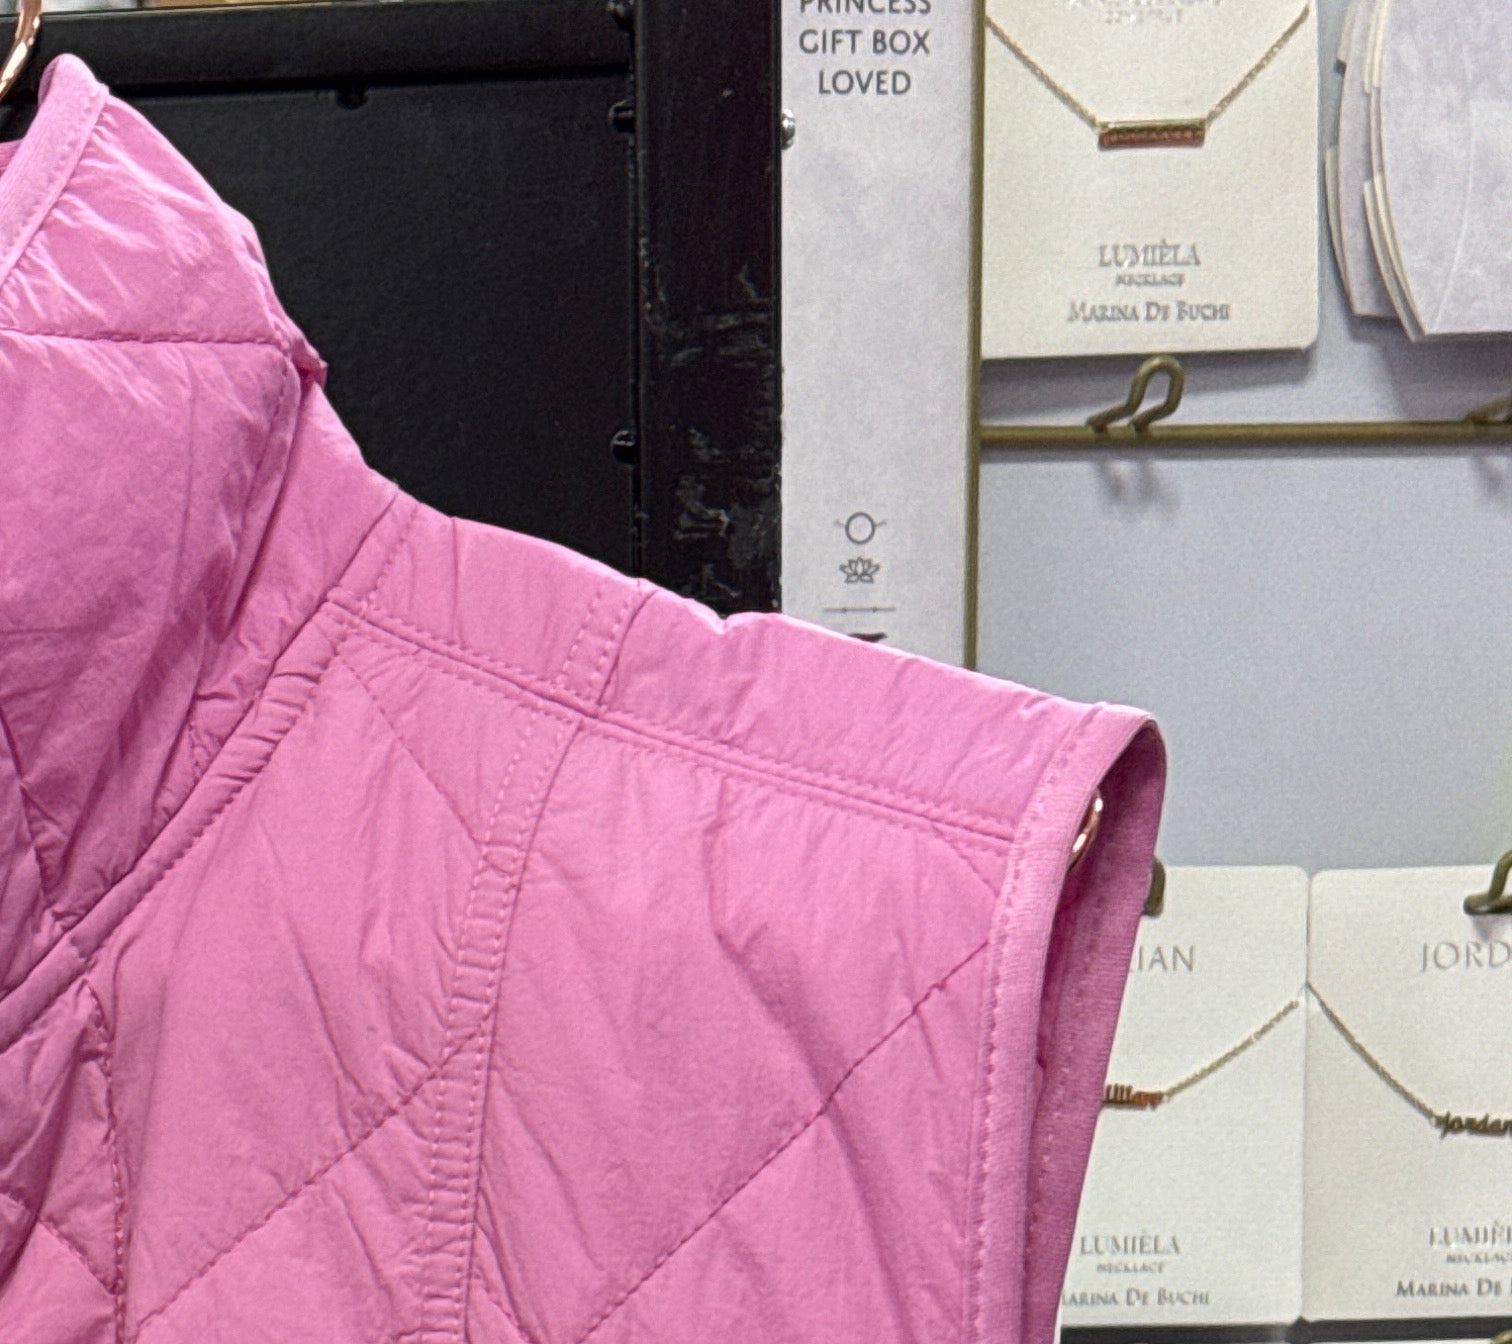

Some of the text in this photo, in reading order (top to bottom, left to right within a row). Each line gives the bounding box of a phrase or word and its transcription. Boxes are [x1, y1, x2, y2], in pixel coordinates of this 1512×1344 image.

[799, 28, 930, 54] GIFT BOX
[818, 69, 911, 95] LOVED
